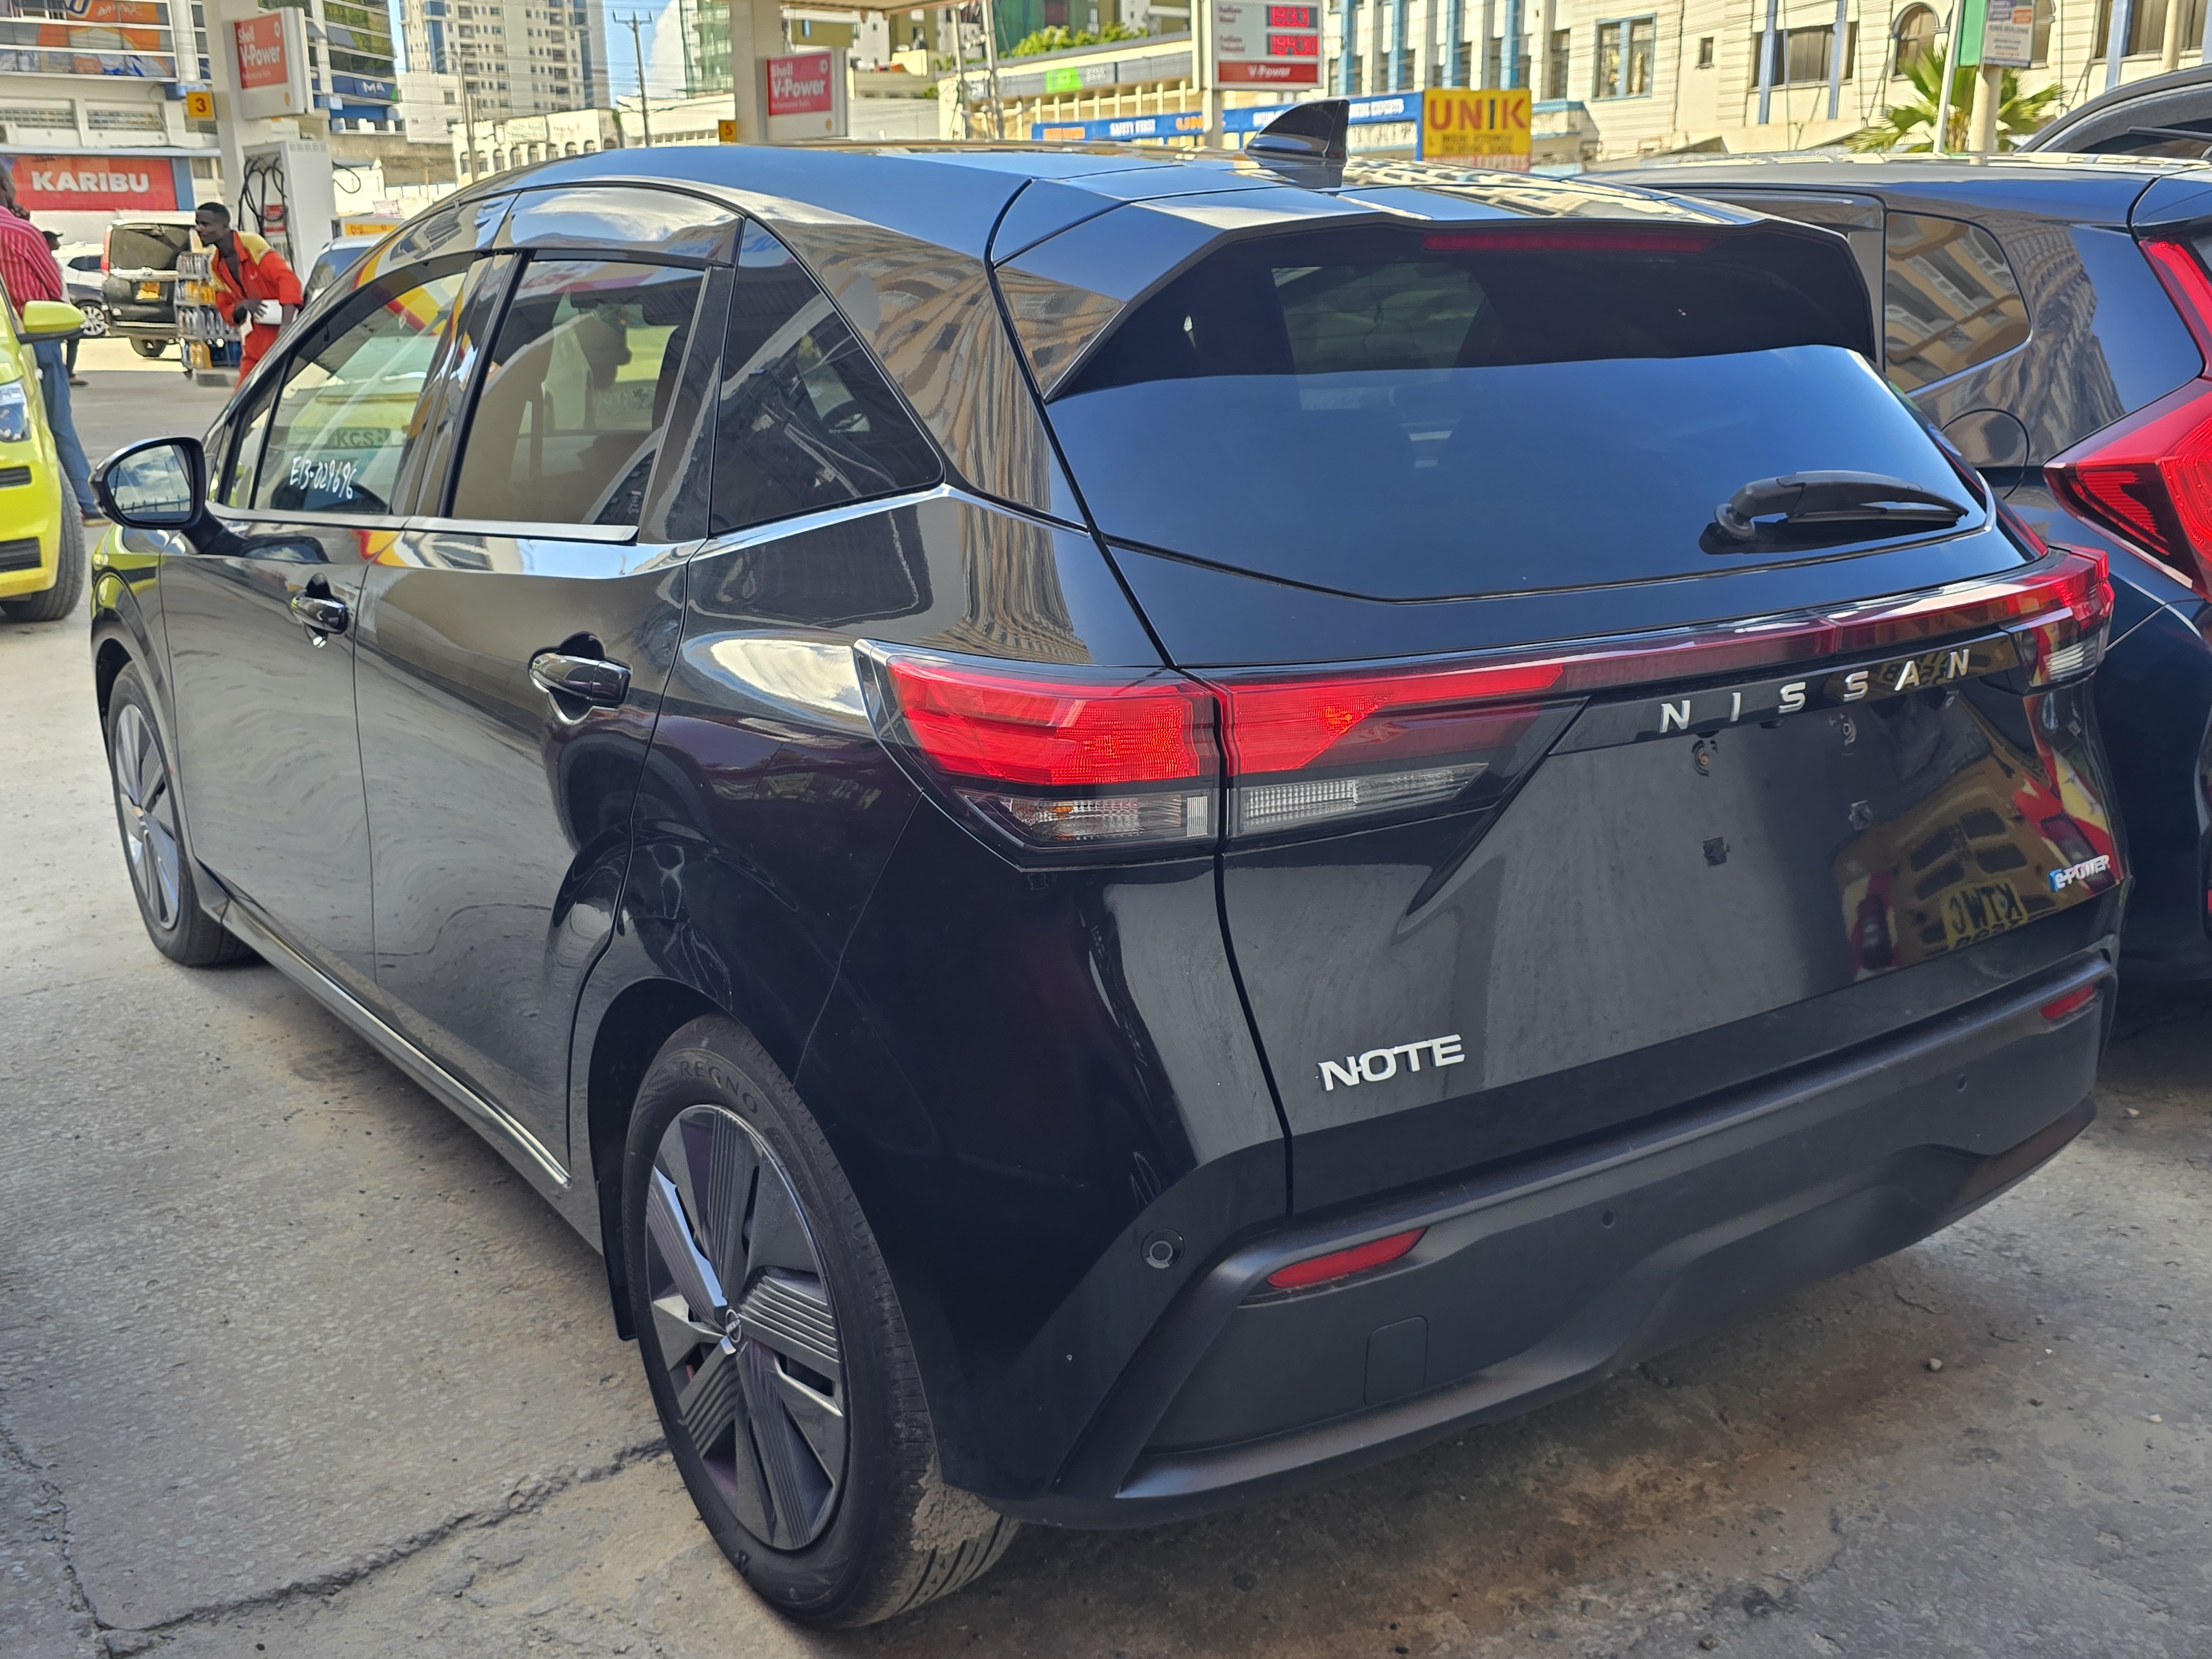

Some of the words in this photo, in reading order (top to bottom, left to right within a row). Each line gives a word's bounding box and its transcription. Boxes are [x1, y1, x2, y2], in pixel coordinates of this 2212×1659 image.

[238, 24, 255, 44] Shell
[239, 43, 281, 68] V-Power
[770, 61, 793, 78] Shell
[771, 77, 827, 100] V-Power
[195, 97, 207, 112] 3
[1430, 98, 1526, 130] UNIK
[31, 170, 150, 193] KARIBU
[1660, 648, 1970, 734] NISSAN
[1317, 1034, 1465, 1091] NOTE
[680, 1060, 758, 1114] REGNO
